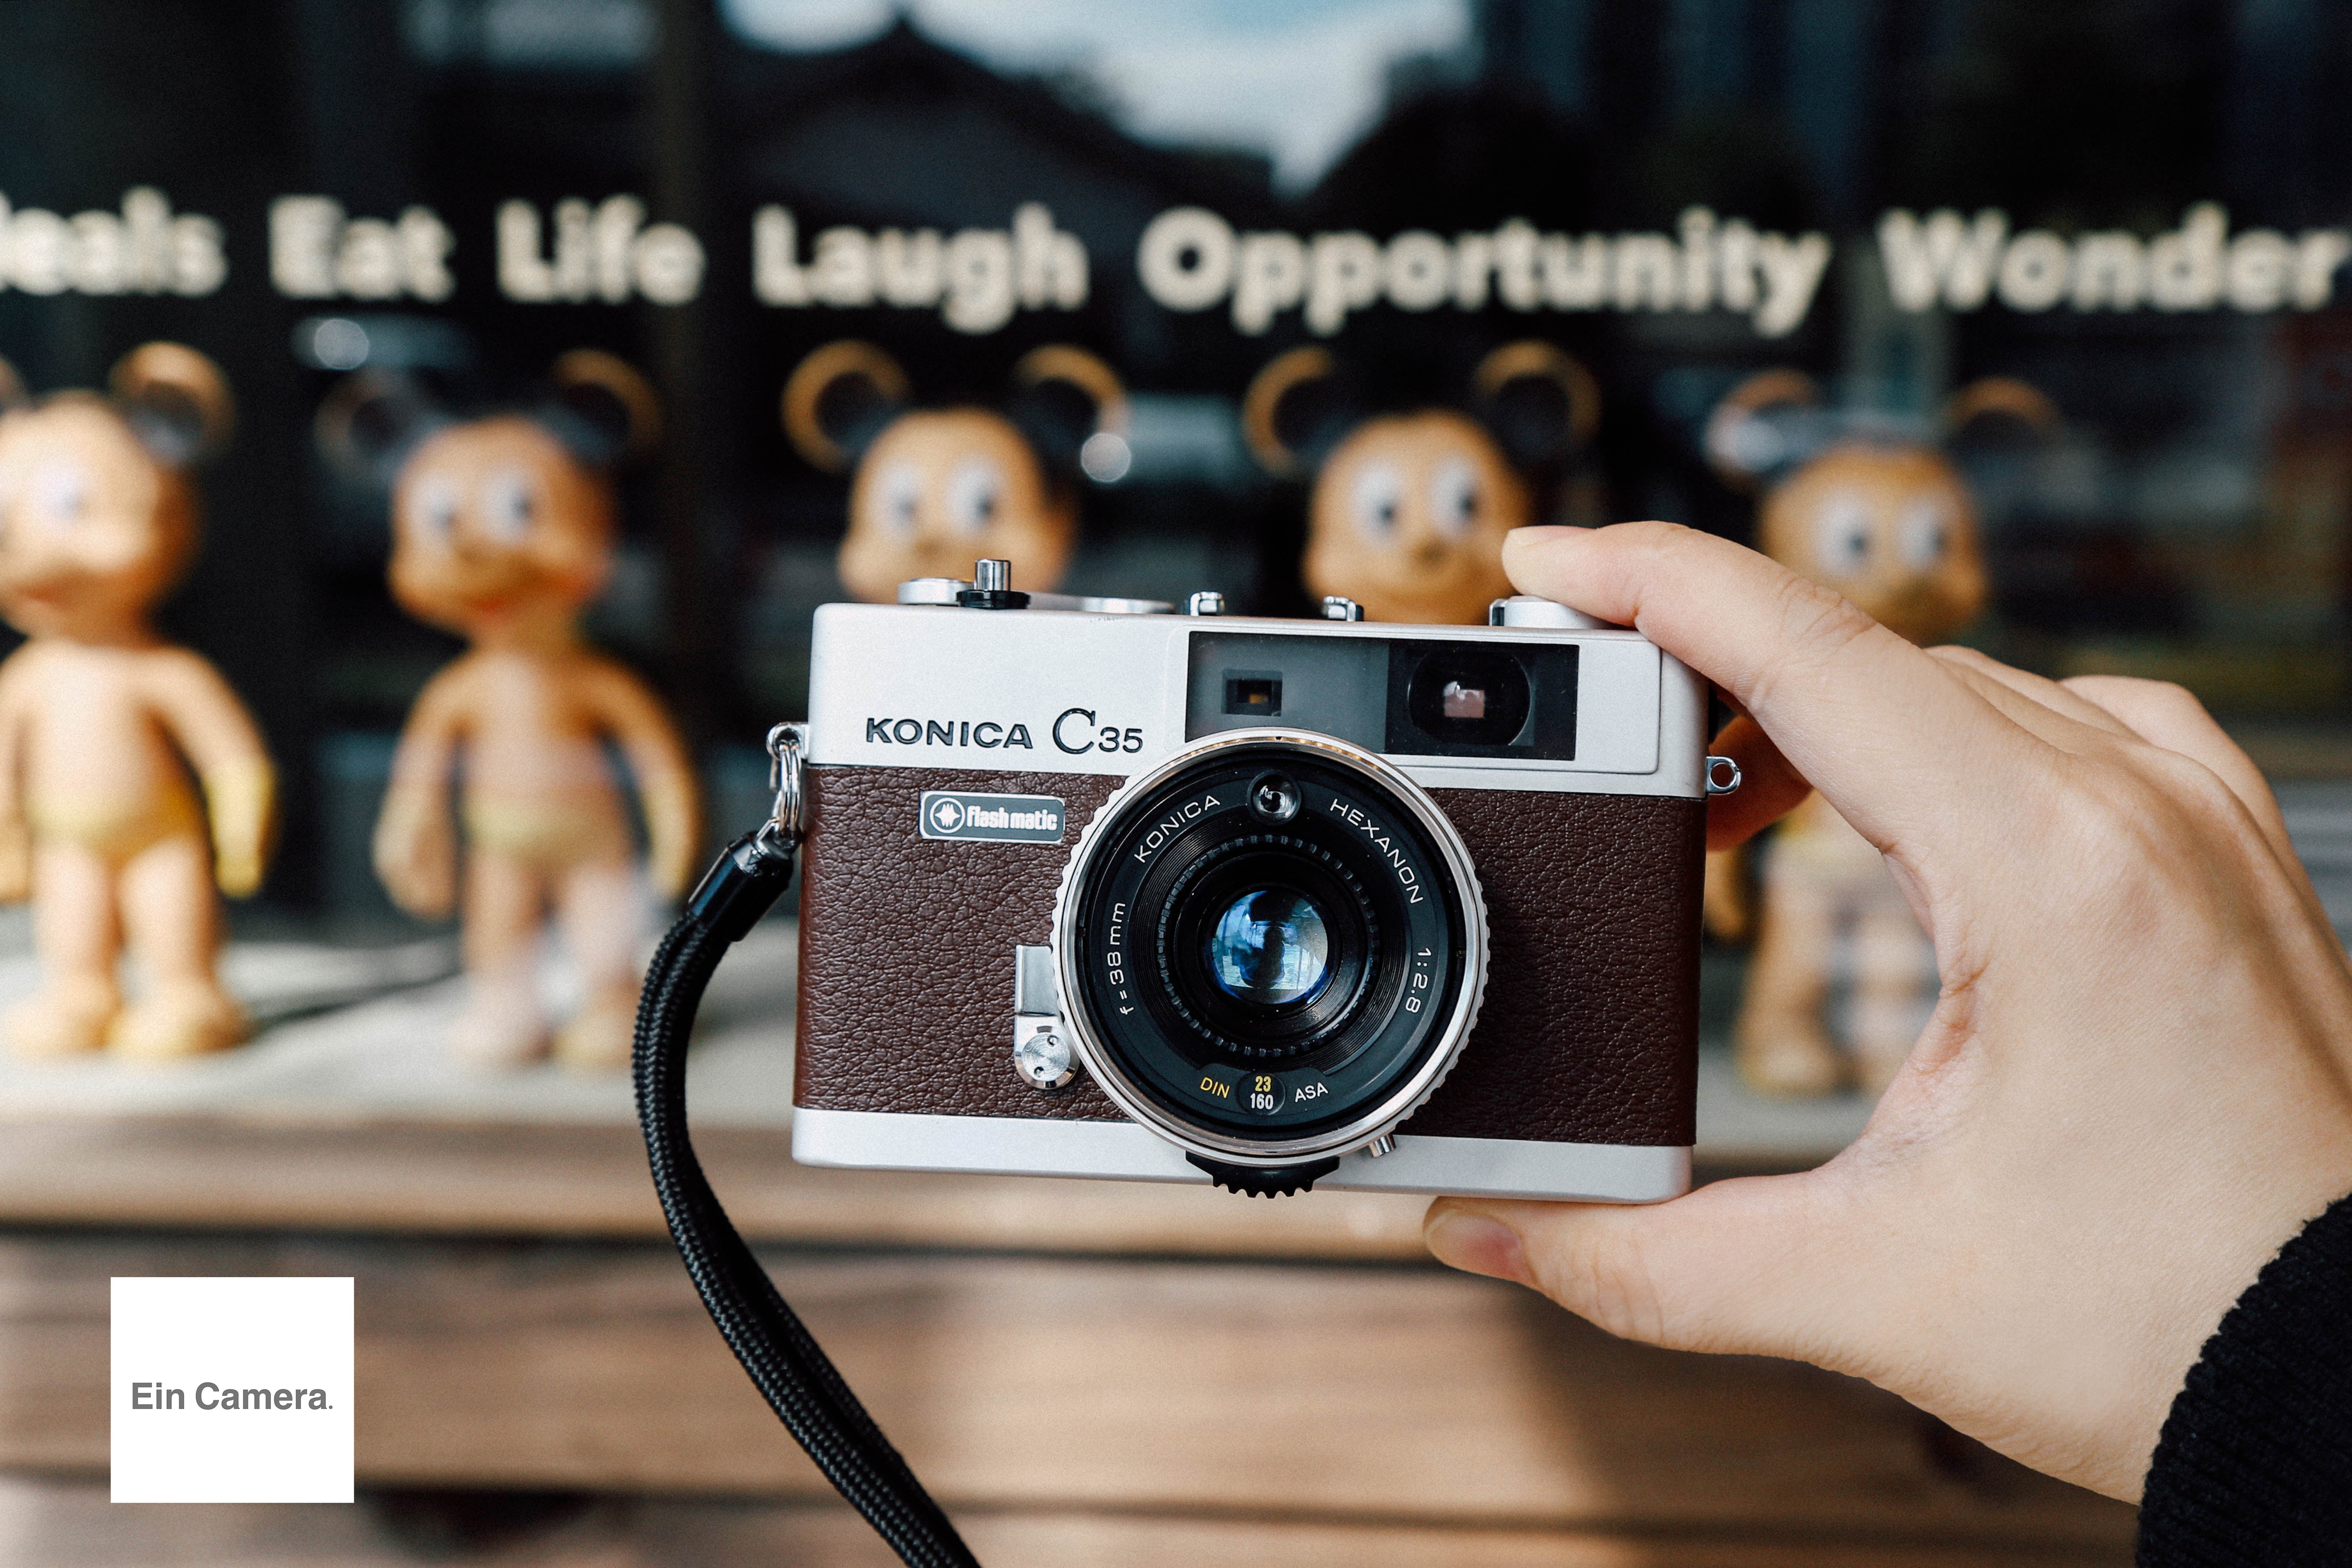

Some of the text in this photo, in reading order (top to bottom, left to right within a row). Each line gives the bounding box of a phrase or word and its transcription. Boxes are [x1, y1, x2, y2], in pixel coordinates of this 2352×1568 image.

[0, 188, 2352, 336] eals Eat Life Laugh Opportunity Wonder
[866, 707, 1143, 755] KONICA C35
[1134, 795, 1424, 904] KONICA HEXANON
[1405, 947, 1432, 1013] 1:2.8
[1200, 1077, 1230, 1099] DIN
[1250, 1093, 1274, 1110] 160
[1255, 1076, 1271, 1093] 23
[1294, 1081, 1329, 1103] ASA
